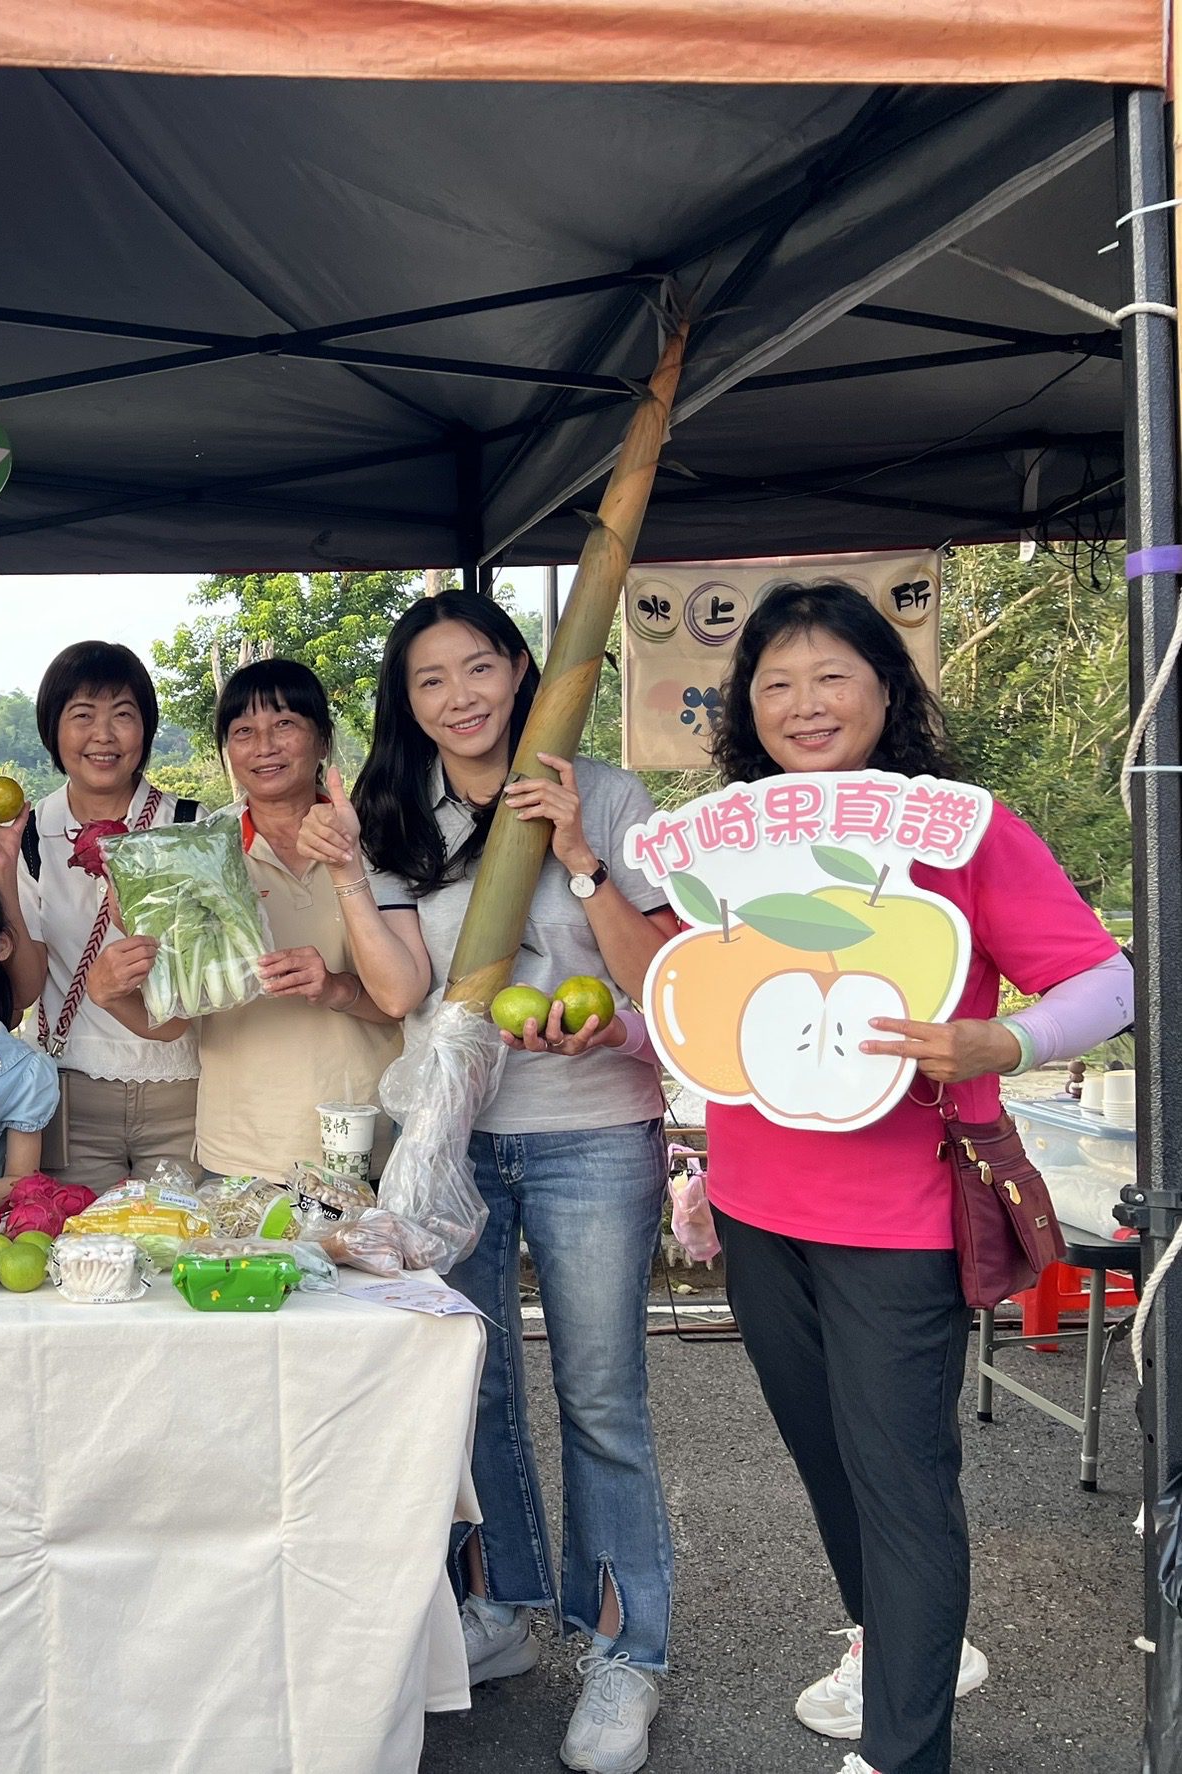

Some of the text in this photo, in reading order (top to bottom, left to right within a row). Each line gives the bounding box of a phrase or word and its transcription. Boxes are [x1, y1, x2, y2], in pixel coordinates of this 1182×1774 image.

[633, 778, 983, 876] 竹崎果真讚
